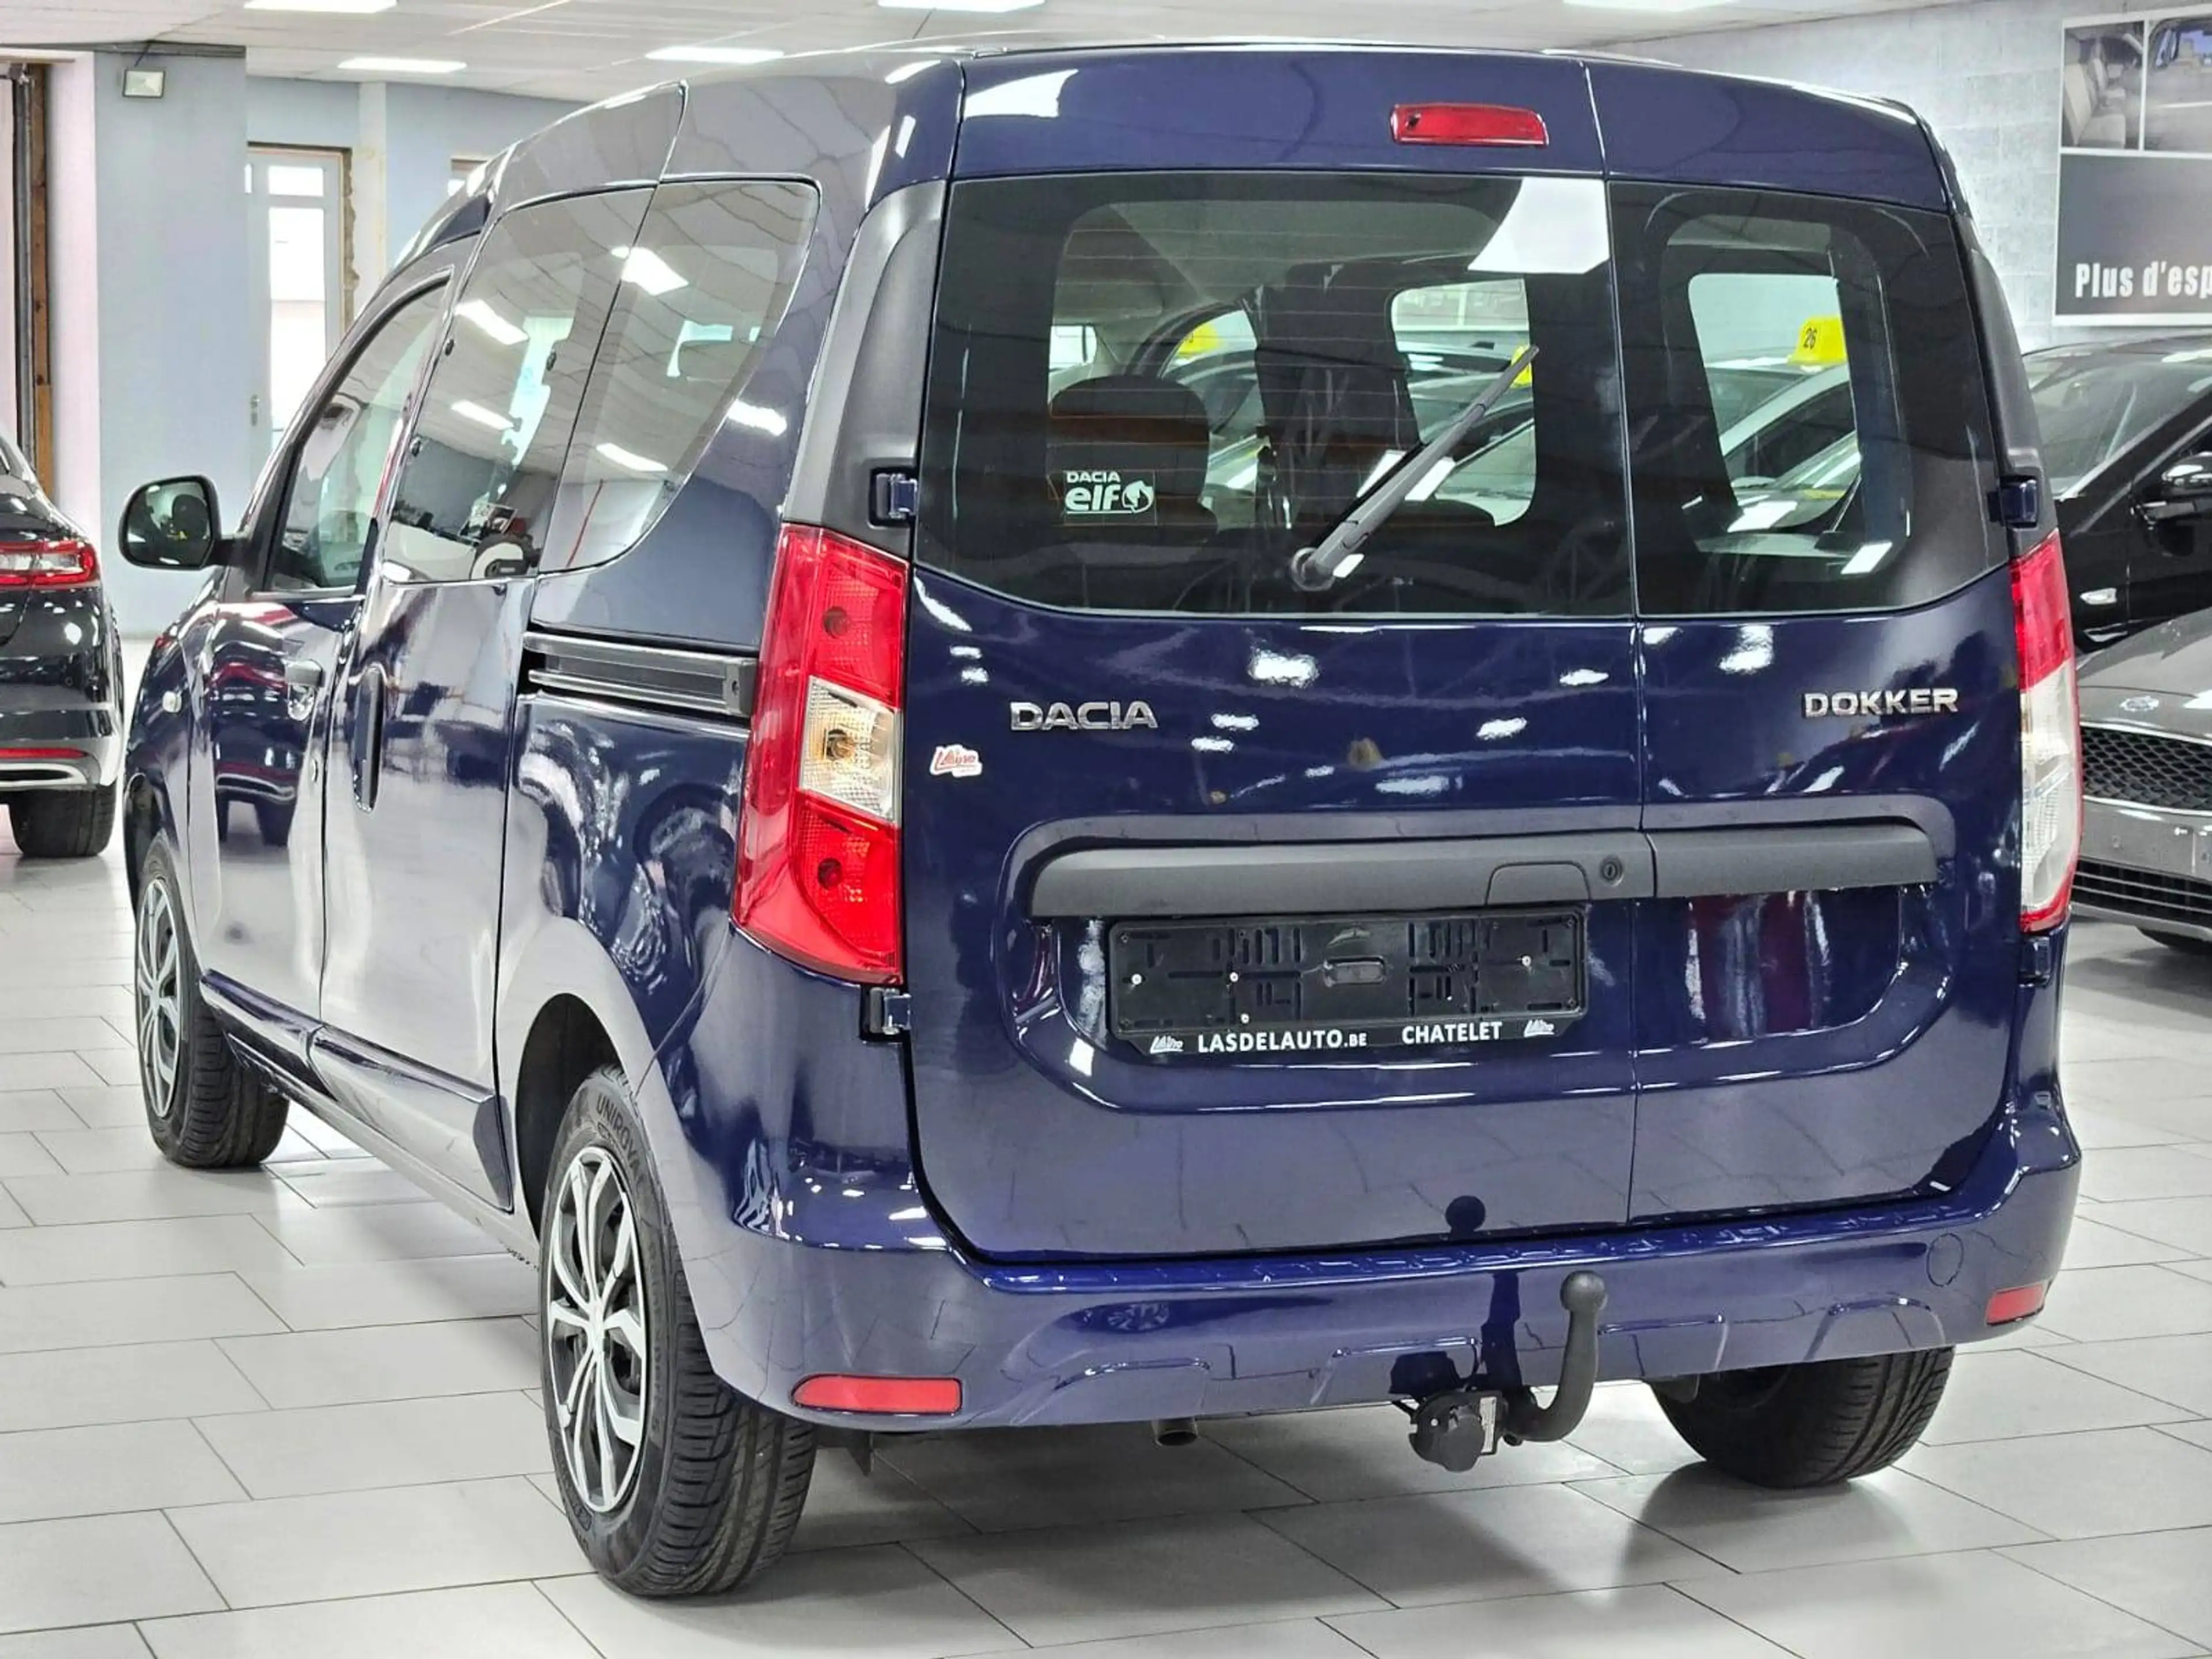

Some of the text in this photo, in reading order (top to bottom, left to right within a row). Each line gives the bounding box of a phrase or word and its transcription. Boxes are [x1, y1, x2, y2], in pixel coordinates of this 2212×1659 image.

[2075, 263, 2134, 298] Plus
[1067, 471, 1121, 483] DACIA
[1065, 484, 1121, 511] elf
[1010, 700, 1158, 730] DACIA
[1804, 688, 1958, 717] DOKKER
[1198, 1029, 1367, 1053] LASDELAUTO.BE
[1402, 1021, 1502, 1044] CHATELET
